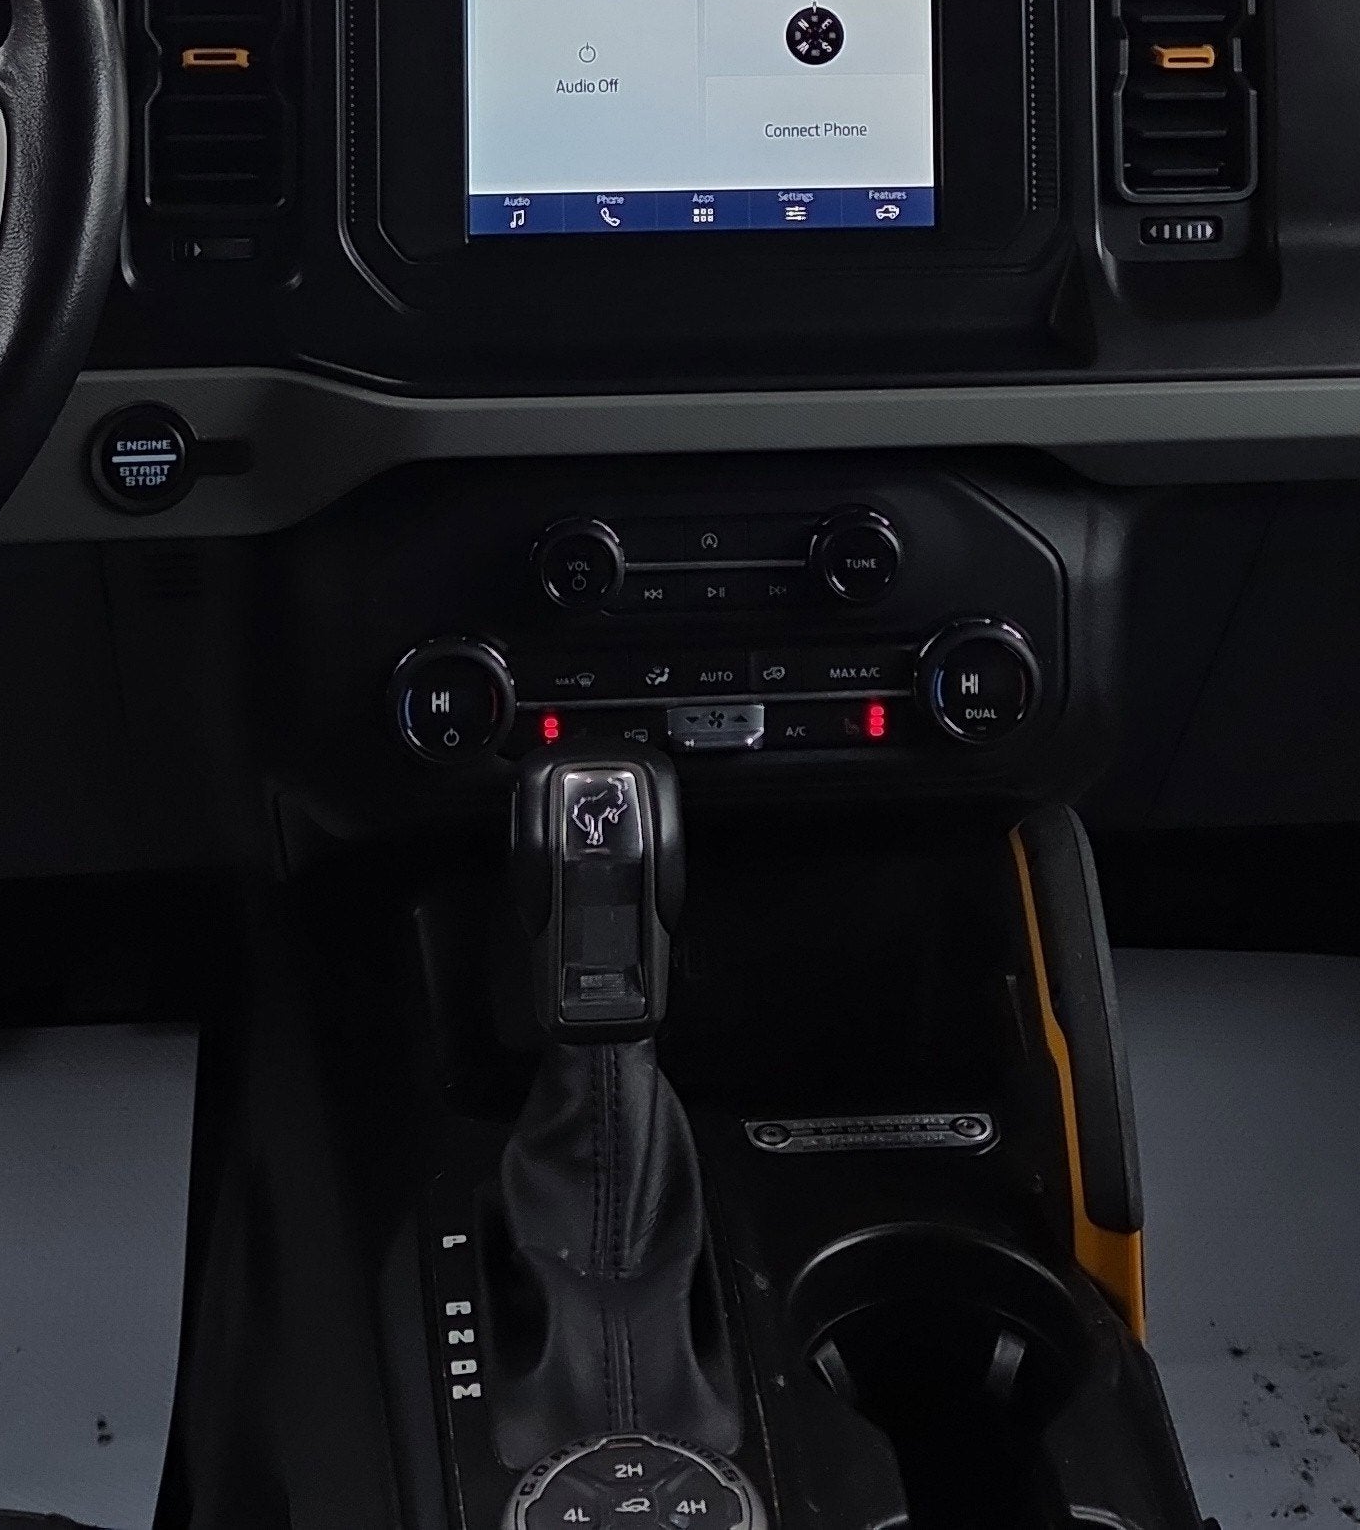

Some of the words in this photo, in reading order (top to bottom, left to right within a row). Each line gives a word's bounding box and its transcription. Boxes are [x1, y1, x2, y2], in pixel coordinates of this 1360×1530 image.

[556, 79, 596, 94] Audio
[598, 78, 619, 93] Off
[765, 123, 821, 138] Connect
[824, 122, 868, 137] Phone
[596, 194, 625, 205] Phone
[692, 193, 715, 204] Apps
[777, 191, 814, 203] Settings
[868, 189, 908, 200] Features
[503, 196, 531, 207] Audio
[116, 439, 172, 452] ENGINE
[119, 464, 170, 476] START
[125, 475, 167, 487] STOP
[566, 560, 590, 571] VOL
[845, 558, 877, 570] TUNE
[699, 671, 733, 683] AUTO
[829, 667, 858, 679] MAX
[859, 666, 881, 679] A/C
[960, 673, 979, 695] HI
[431, 691, 450, 713] HI
[965, 708, 997, 719] DUAL
[785, 726, 807, 737] A/C
[442, 1234, 468, 1249] P
[448, 1328, 475, 1345] N
[450, 1359, 478, 1376] D
[452, 1382, 482, 1400] M
[614, 1462, 644, 1479] 2H
[675, 1499, 707, 1515] 4H
[563, 1507, 591, 1523] 4L
